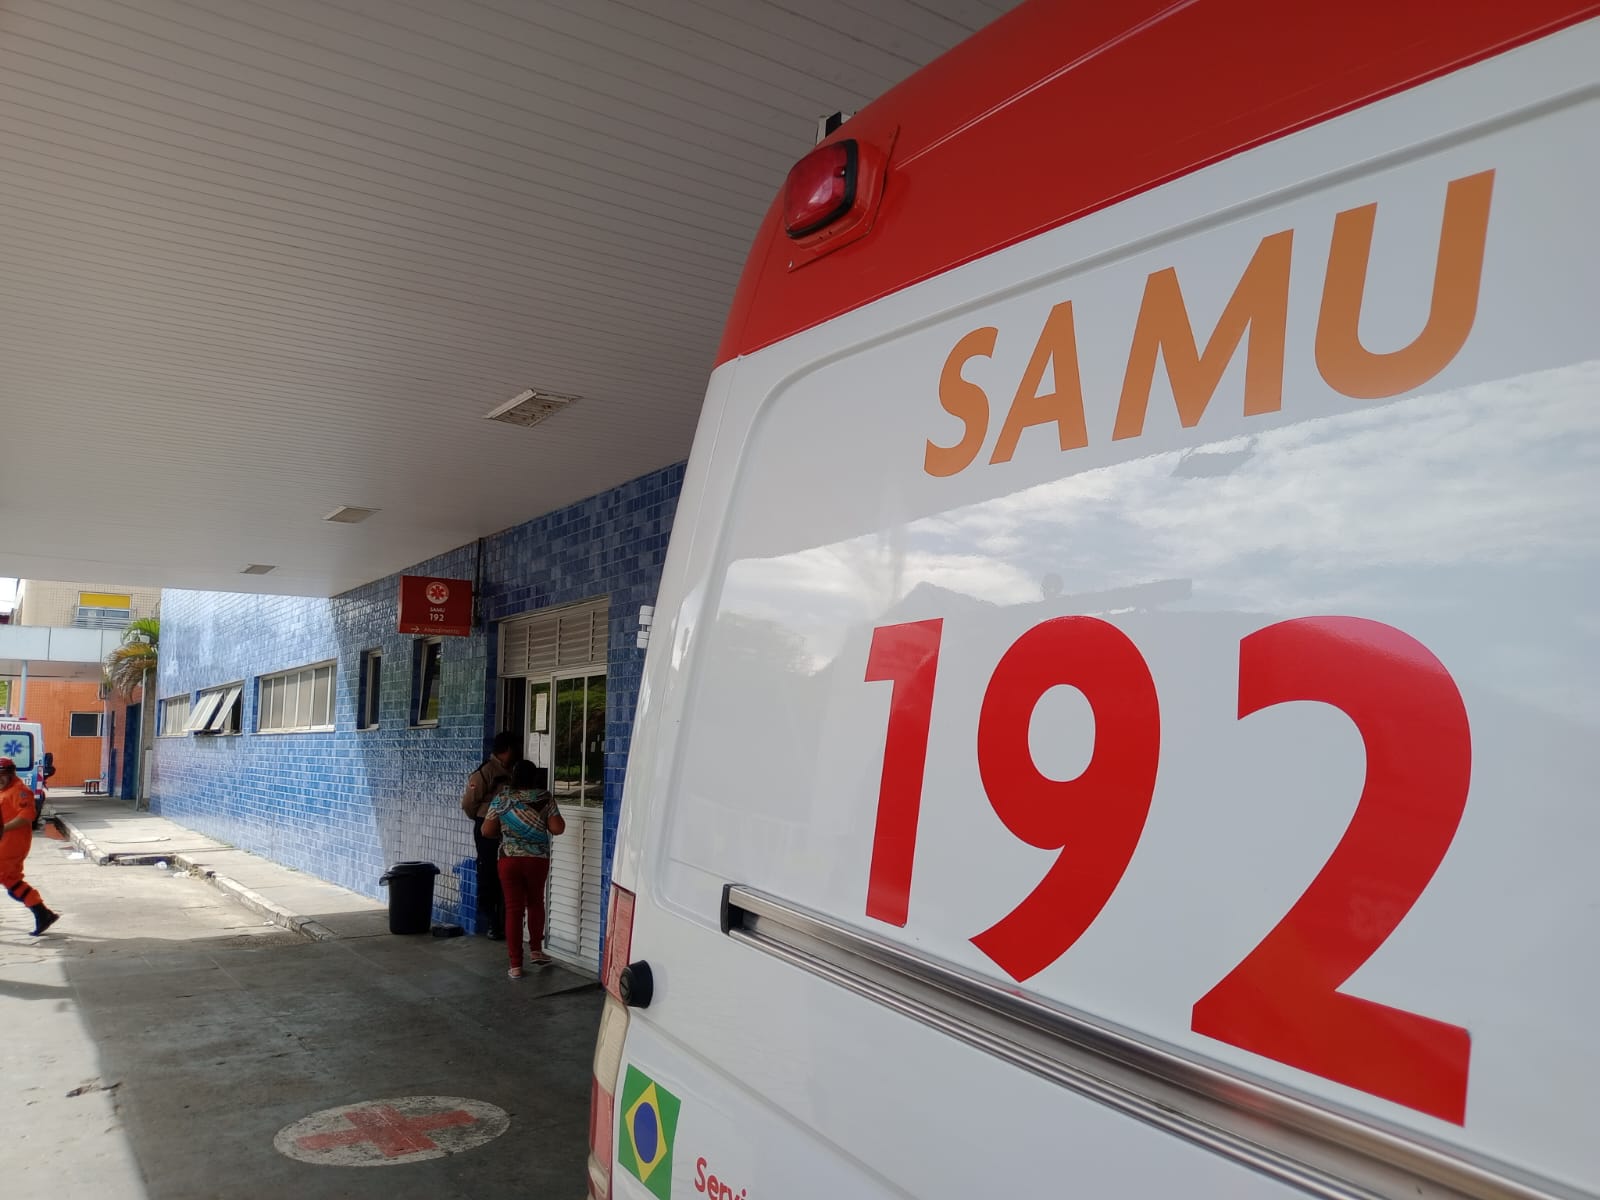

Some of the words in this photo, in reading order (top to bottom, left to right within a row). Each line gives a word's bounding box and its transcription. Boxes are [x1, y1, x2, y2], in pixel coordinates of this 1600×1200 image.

[924, 168, 1496, 477] SAMU
[429, 613, 444, 622] 192
[864, 615, 1472, 1127] 192
[694, 1156, 747, 1200] Ser
